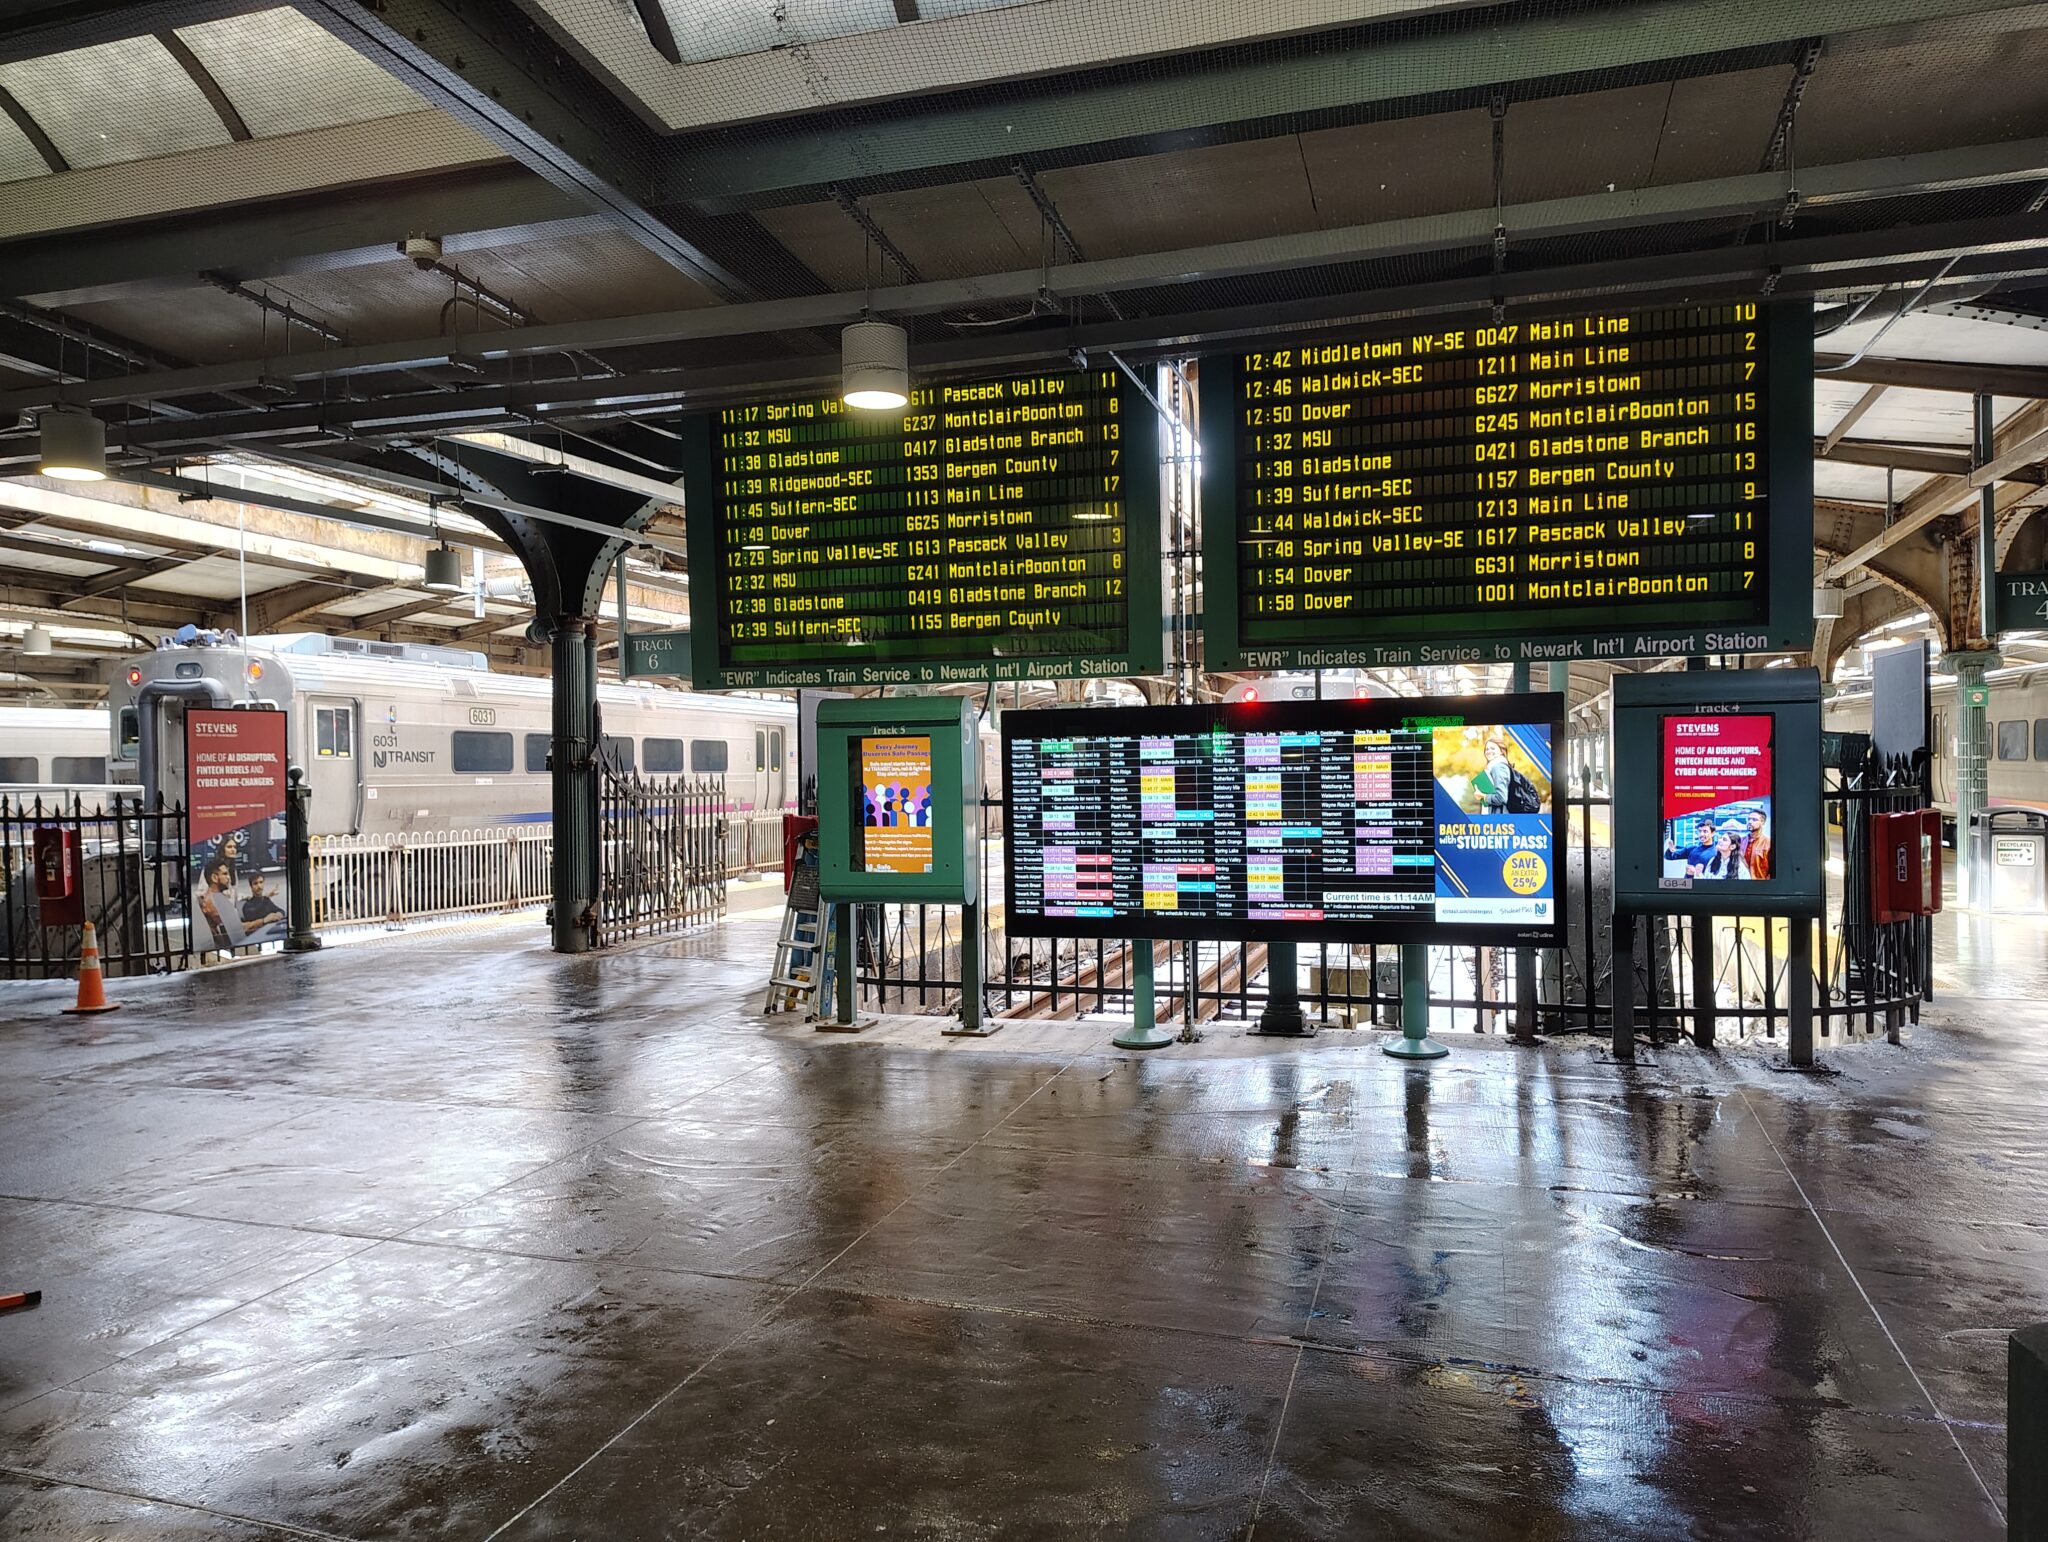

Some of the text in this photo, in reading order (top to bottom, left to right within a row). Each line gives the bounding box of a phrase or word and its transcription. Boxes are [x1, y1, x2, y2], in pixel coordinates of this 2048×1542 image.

[1246, 304, 1755, 370] 12:42 Middletown NY-SE 0047 Main Line 10
[723, 407, 758, 423] 11:17
[767, 404, 813, 420] Spring
[944, 384, 1003, 402] Pascack
[1012, 379, 1064, 396] Valley
[1102, 372, 1115, 388] 11
[1247, 362, 1755, 425] 12:50 Dover 6627 Morristown 7
[724, 398, 1118, 446] 11:32 MSU 6237 MontclairBoonton 8
[1256, 393, 1755, 451] 1:32 MSU 6245 MontclairBoonton 15
[725, 424, 1118, 471] 11:38 Gladstone 0417 Gladstone Branch 13
[1257, 423, 1755, 478] 1:38 Gladstone 0421 Gladstone Branch 16
[726, 450, 1118, 495] 11:39 Ridgewood-SEC 1353 Bergen County 7
[727, 476, 1119, 518] 11:45 Suffern-SEC 1113 Main Line 17
[728, 502, 1118, 542] 11:49 Dover 6625 Morristown 11
[1258, 512, 1751, 558] 1:48 Spring Valley-SE 1617 Pascack Valley 11
[633, 639, 672, 651] TRACK
[1297, 649, 1367, 666] Indicates
[1374, 646, 1411, 663] Train
[1420, 644, 1481, 662] Service
[1495, 644, 1510, 659] to
[1520, 639, 1583, 658] Newark
[1592, 637, 1623, 655] Int'l
[1634, 634, 1695, 654] Airport
[1704, 632, 1768, 651] Station
[649, 654, 658, 669] 6
[766, 668, 823, 684] Indicates
[826, 667, 857, 683] Train
[863, 666, 911, 682] Service
[921, 666, 934, 680] to
[940, 663, 988, 681] Newark
[995, 662, 1020, 678] Int'l
[1027, 660, 1073, 678] Airport
[1080, 658, 1128, 675] Station
[1732, 704, 1740, 712] 4
[472, 711, 493, 723] 6031
[196, 723, 237, 733] STEVENS
[872, 726, 906, 734] Track 5
[964, 713, 972, 744] 5
[1676, 724, 1719, 733] STEVENS
[373, 736, 398, 747] 6031
[1675, 746, 1761, 756] HOME OF AI DISRUPTORS,
[196, 753, 278, 763] HOME OF AI DISRUPTORS,
[373, 751, 435, 768] NJ TRANSIT
[1675, 757, 1745, 765] FINTECH REBELS AND
[196, 765, 264, 775] FINTECH REBELS AND
[1675, 768, 1757, 776] CYBER GAME-CHANGERS
[197, 777, 274, 788] CYBER GAME-CHANGERS
[1439, 823, 1515, 835] BACK TO CLASS
[1439, 835, 1547, 849] with STUDENT PASS!
[1512, 858, 1537, 869] SAVE
[1513, 878, 1537, 888] 25%
[1326, 893, 1432, 901] Current time is 11:14AM
